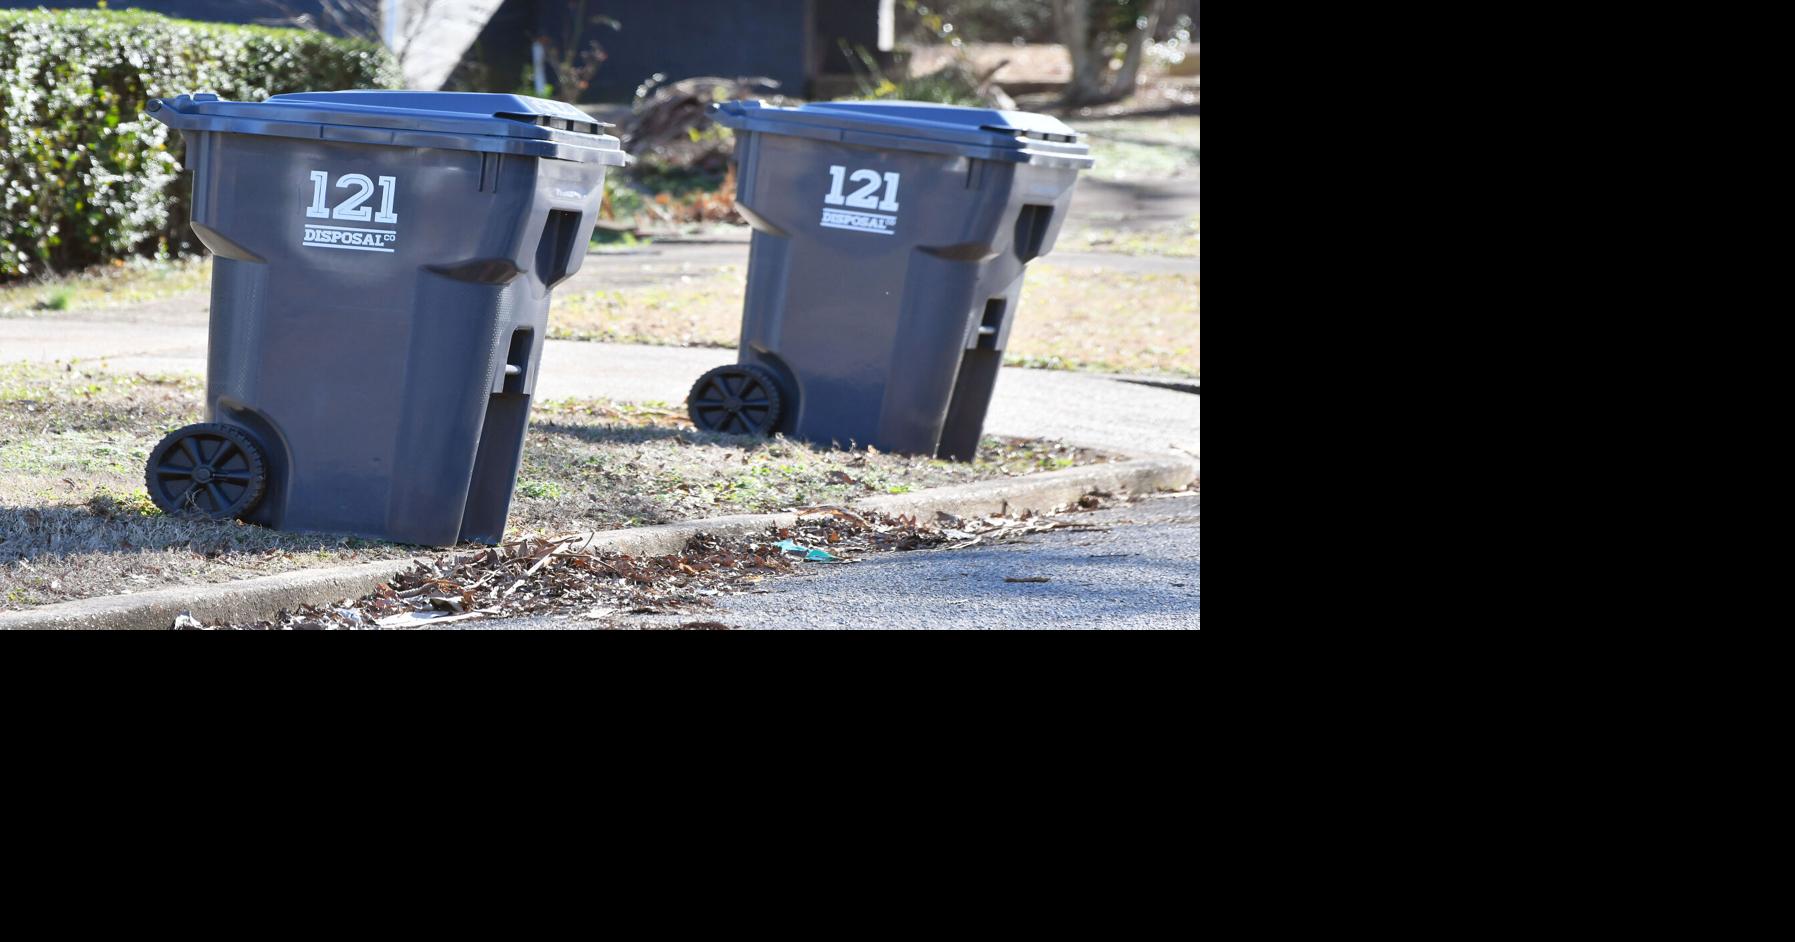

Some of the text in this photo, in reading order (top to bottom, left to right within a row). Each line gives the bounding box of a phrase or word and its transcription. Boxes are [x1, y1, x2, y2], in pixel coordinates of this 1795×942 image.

[306, 170, 397, 224] 121
[824, 165, 900, 212] 121
[821, 211, 886, 229] DISPOSAL
[304, 229, 384, 247] DISPOSAL
